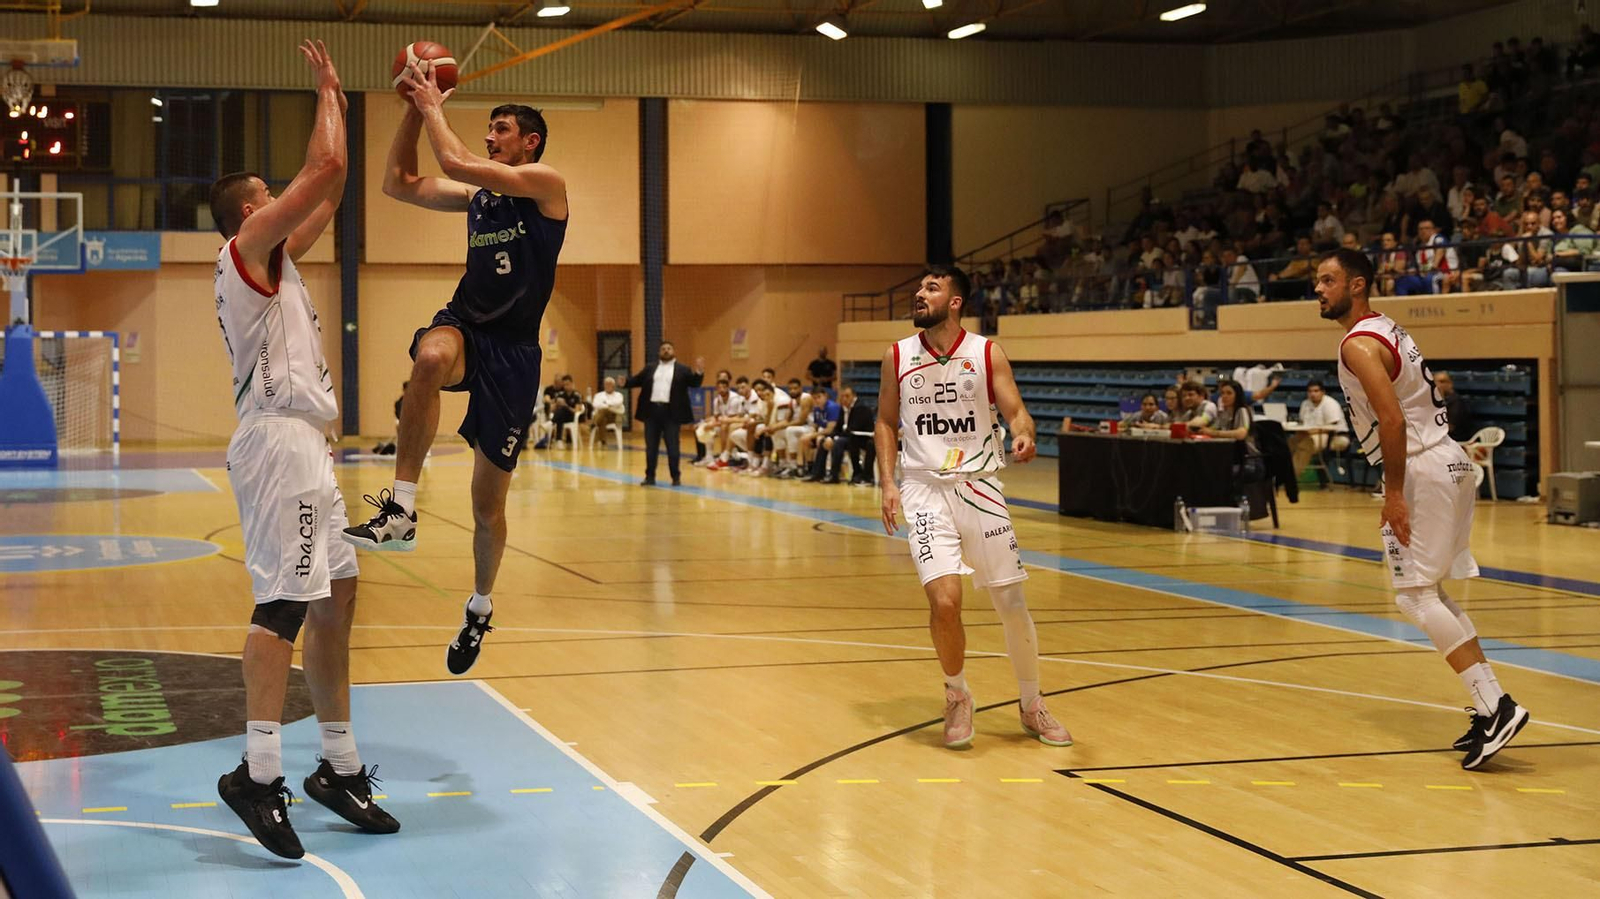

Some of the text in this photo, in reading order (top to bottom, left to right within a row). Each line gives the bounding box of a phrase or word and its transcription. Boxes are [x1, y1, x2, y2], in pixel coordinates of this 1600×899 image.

[495, 251, 512, 275] 3
[908, 396, 931, 405] alsa
[934, 382, 958, 403] 25
[915, 410, 976, 435] fibwi
[501, 435, 518, 457] 3
[295, 500, 314, 578] ibacar
[915, 512, 934, 564] ibacar
